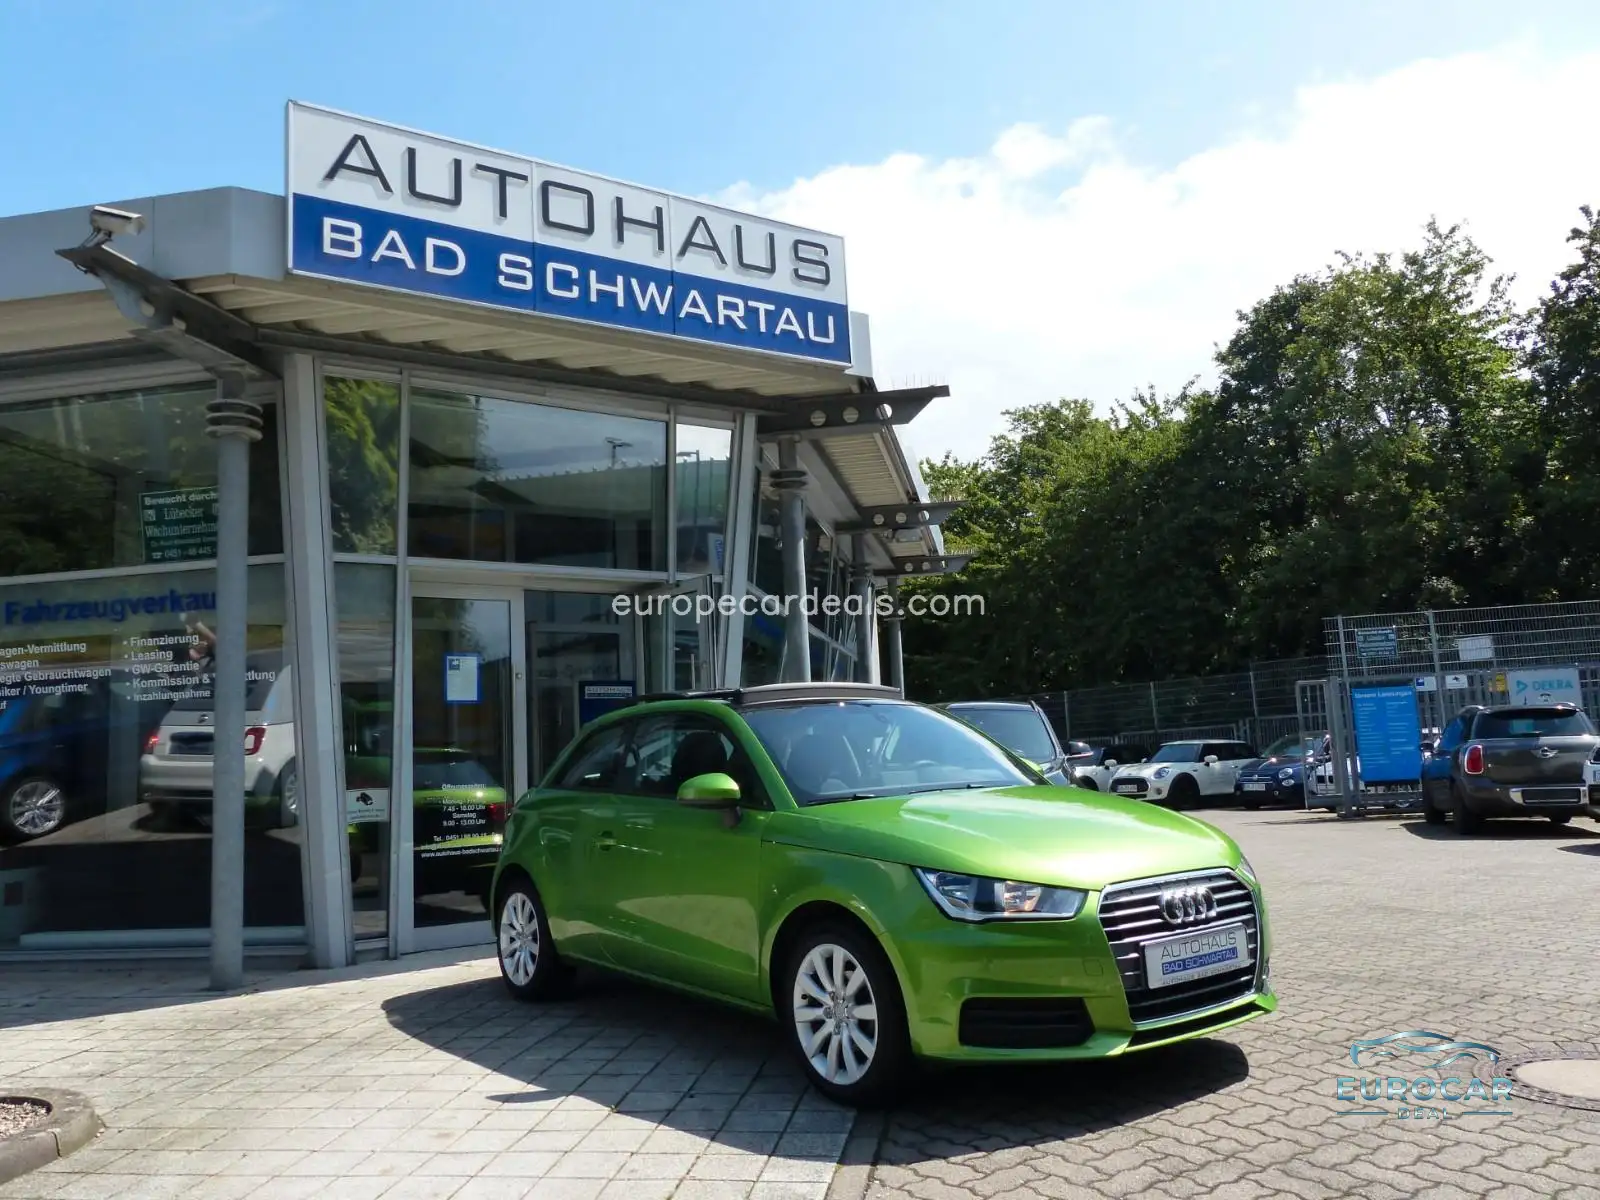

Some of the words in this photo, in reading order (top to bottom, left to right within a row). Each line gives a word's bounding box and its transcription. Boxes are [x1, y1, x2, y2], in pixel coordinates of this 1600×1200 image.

[322, 133, 831, 287] AUTOHAUS
[322, 217, 467, 278] BAD
[498, 252, 835, 344] SCHWARTAU
[130, 634, 200, 647] Finanzierung
[131, 649, 173, 661] Leasing
[24, 668, 112, 681] Gebrauchtwagen
[132, 661, 200, 675] GW-Garantie
[132, 675, 200, 688] Kommission
[202, 672, 210, 684] &
[28, 682, 89, 695] Youngtimer
[133, 689, 211, 702] Inzahlungnahme
[1161, 931, 1237, 960] AUTOHAUS
[1163, 961, 1184, 973] BAD
[1185, 949, 1238, 969] SCHWARTAU
